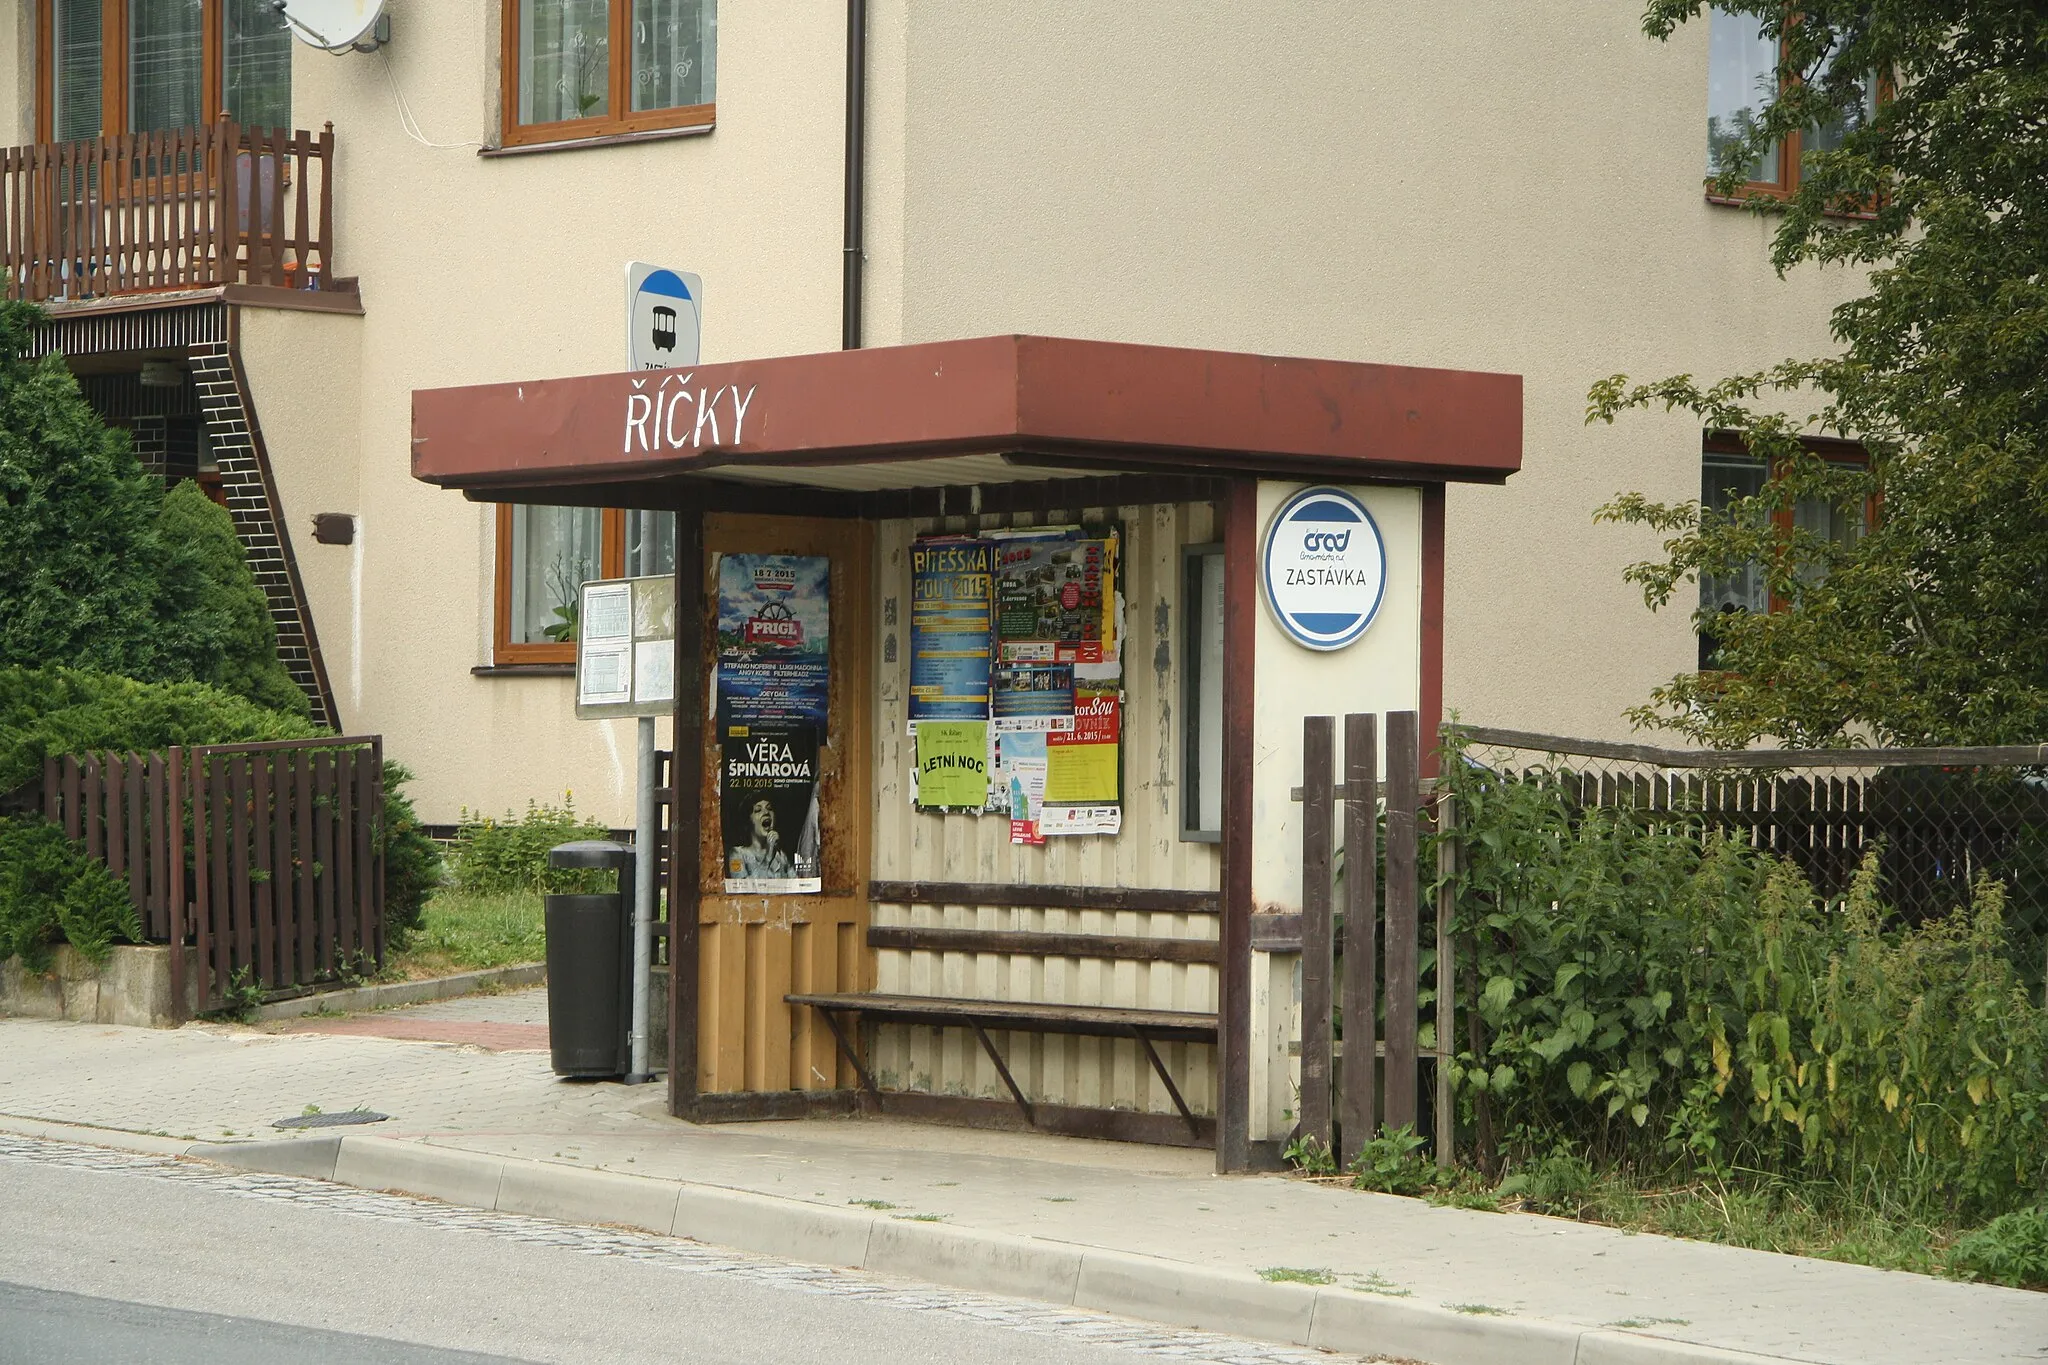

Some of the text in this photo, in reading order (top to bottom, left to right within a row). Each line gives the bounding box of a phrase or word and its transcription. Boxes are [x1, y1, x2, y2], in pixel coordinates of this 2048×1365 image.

[625, 373, 757, 453] ŘÍČKY
[914, 547, 987, 573] BÍTEŠSKÁ
[1286, 566, 1367, 586] ZASTÁVKA
[752, 621, 797, 635] PRIGL
[746, 737, 794, 762] VĚRA
[728, 758, 811, 777] ŠPINAROVÁ
[923, 752, 984, 774] LETNÍ NOC
